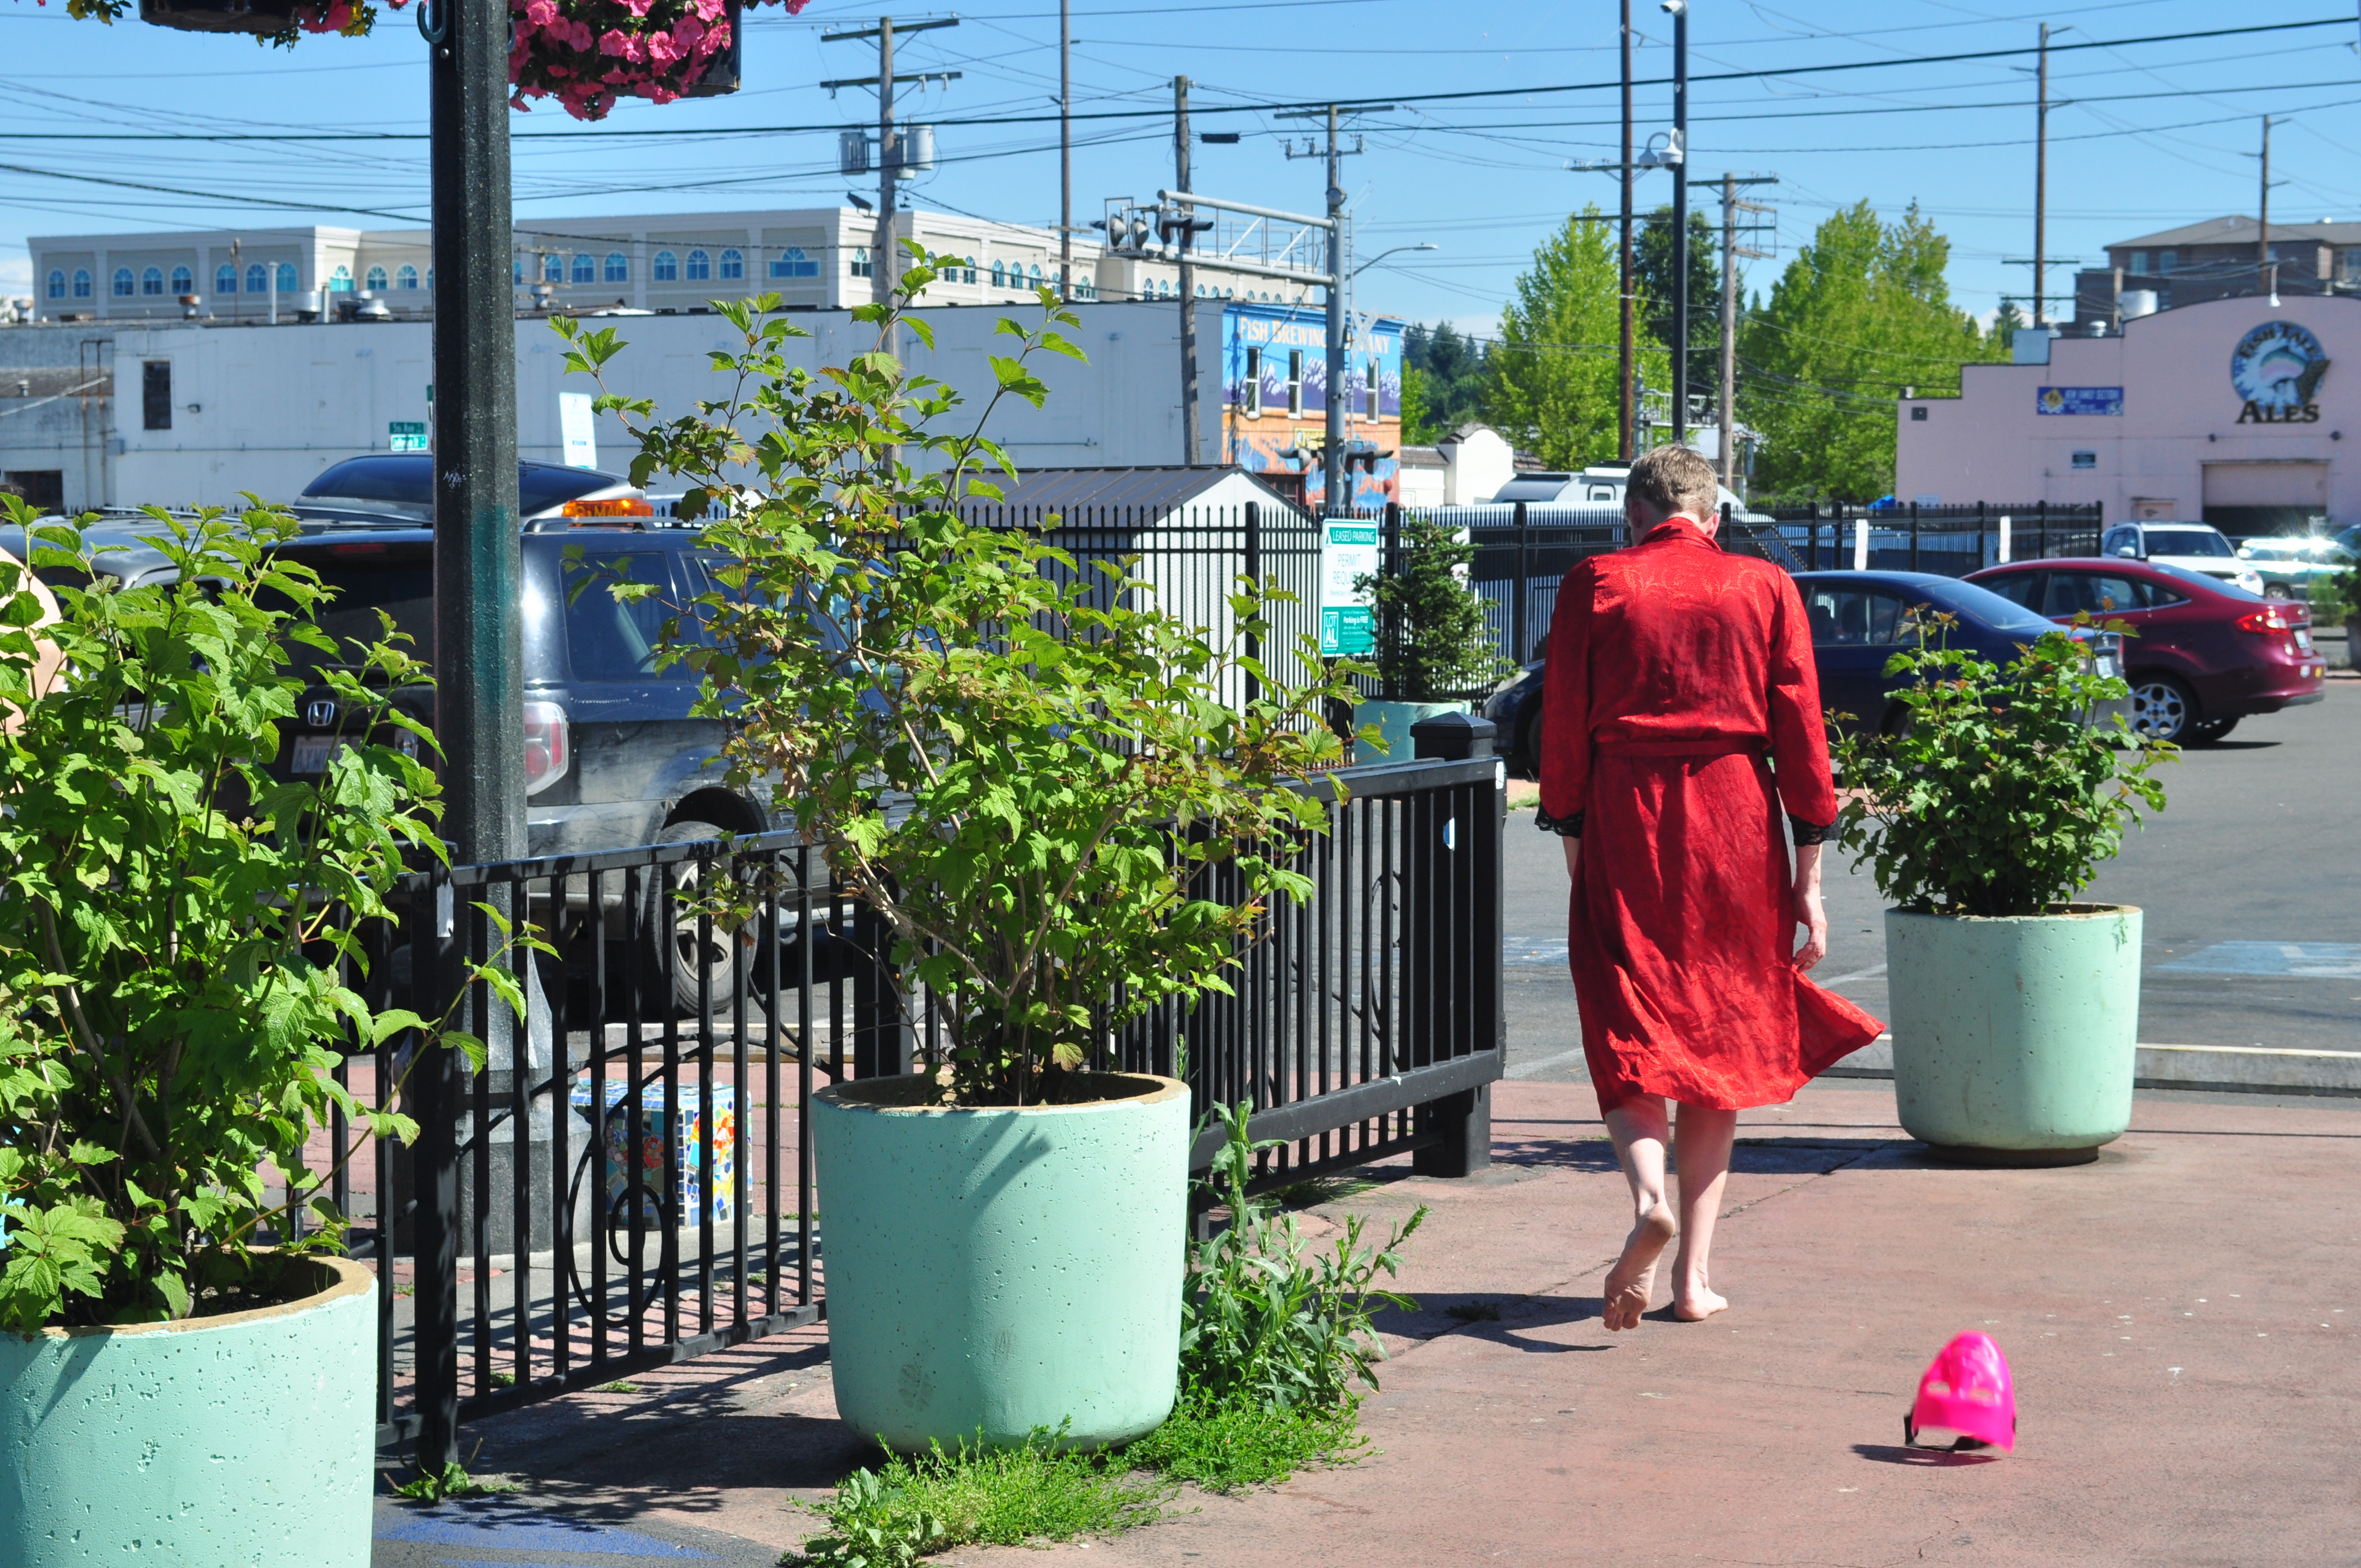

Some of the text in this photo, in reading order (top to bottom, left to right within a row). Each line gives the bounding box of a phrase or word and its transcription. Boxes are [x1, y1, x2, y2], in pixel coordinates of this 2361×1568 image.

[1240, 317, 1269, 342] FISH
[2239, 328, 2275, 360] FISH
[2235, 400, 2320, 424] ALES
[1332, 530, 1375, 543] LEASED PARKING
[1337, 553, 1361, 567] PERMIT
[1325, 615, 1337, 628] LOT
[1325, 627, 1337, 644] AL
